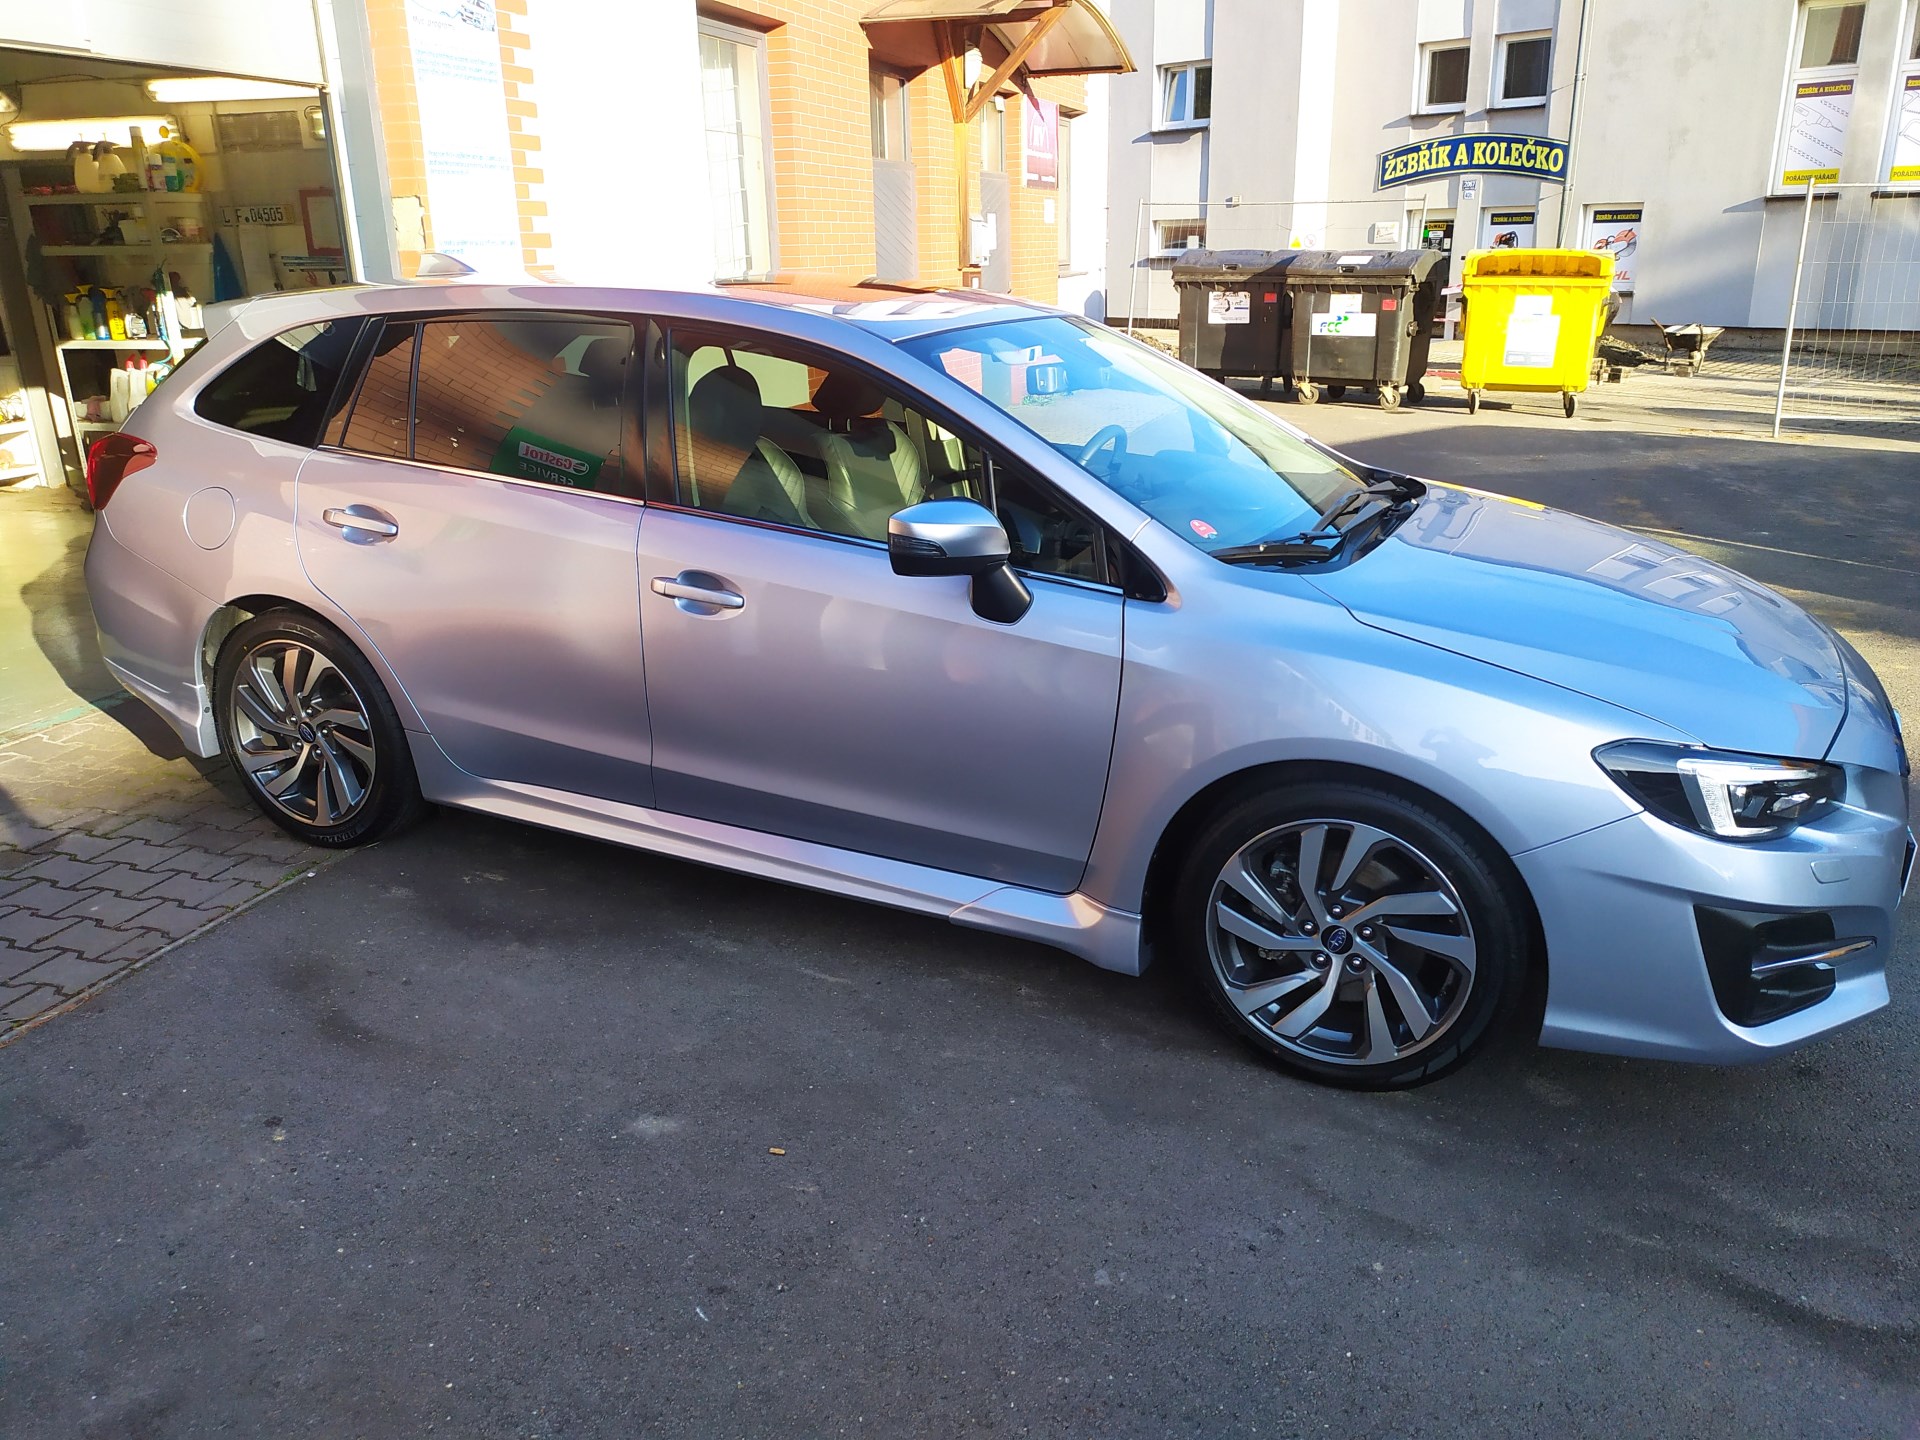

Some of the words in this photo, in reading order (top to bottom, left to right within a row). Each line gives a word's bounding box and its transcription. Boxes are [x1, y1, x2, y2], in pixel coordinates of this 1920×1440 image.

[1384, 141, 1452, 181] ŽEBŘÍK
[1453, 143, 1469, 167] A
[1472, 138, 1564, 173] KOLEČKO
[1320, 322, 1342, 333] FCC
